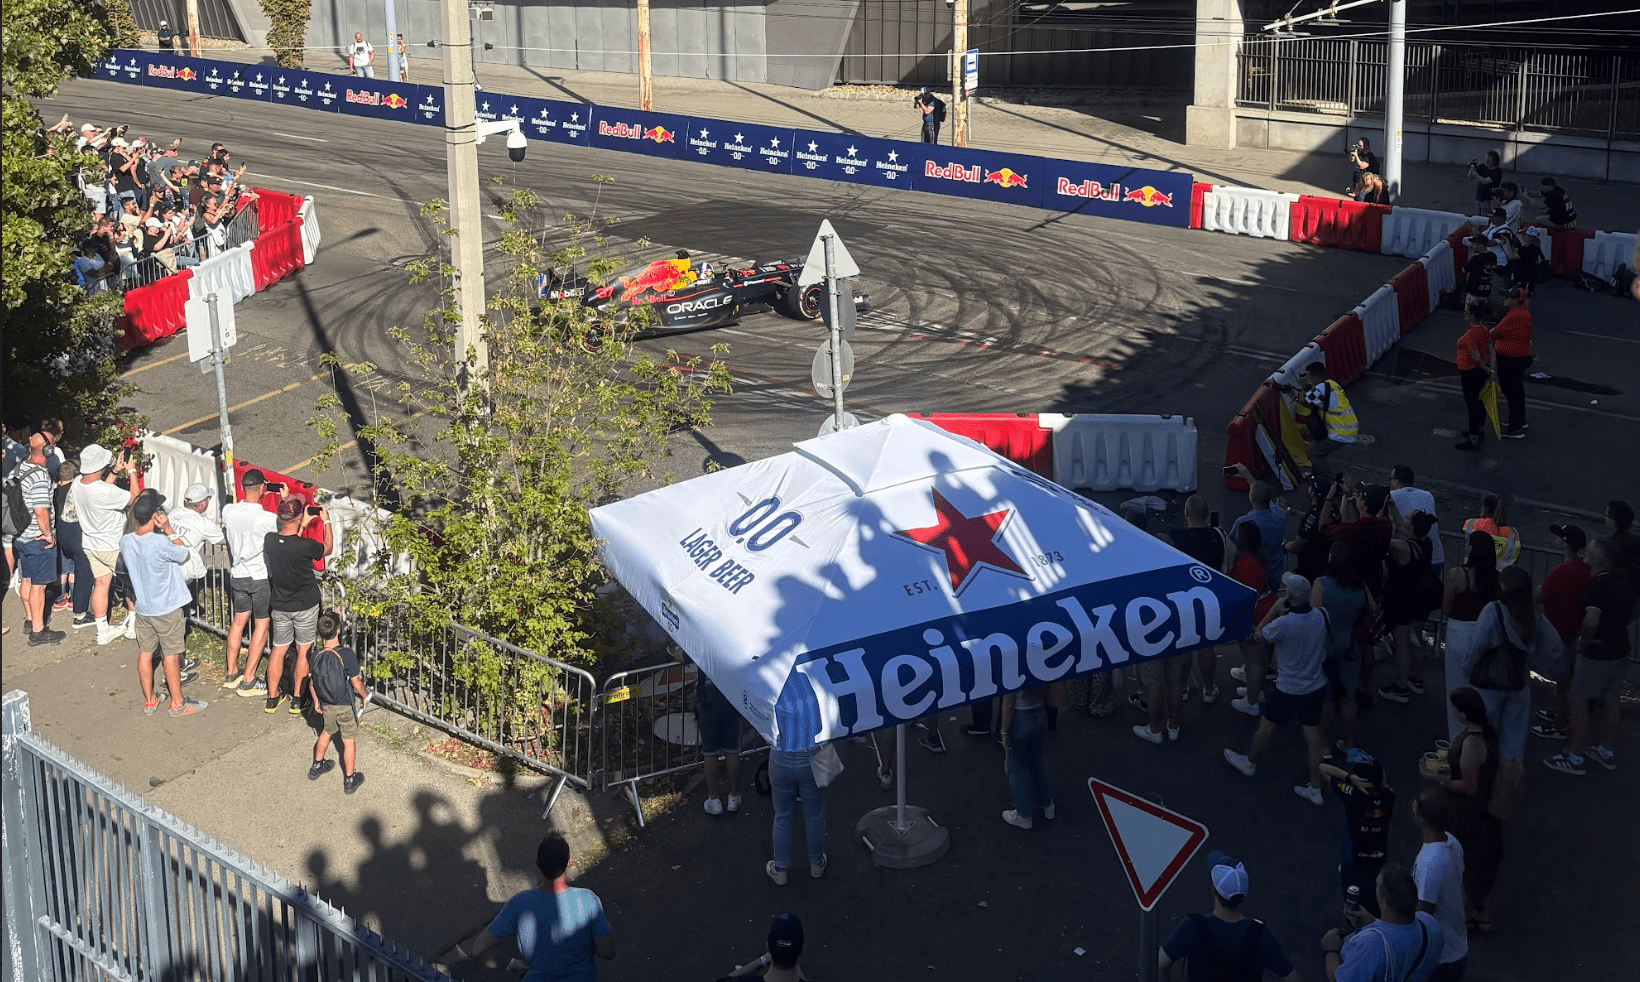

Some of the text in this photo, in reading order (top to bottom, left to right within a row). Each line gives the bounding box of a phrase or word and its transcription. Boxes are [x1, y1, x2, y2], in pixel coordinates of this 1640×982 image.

[690, 137, 718, 147] Heineken
[724, 142, 753, 152] Heineken
[759, 147, 789, 157] Heineken
[796, 151, 828, 161] Heineken
[835, 156, 868, 166] Heineken
[876, 160, 909, 171] Heineken
[666, 294, 733, 315] ORACLE
[726, 494, 804, 553] 0.0
[679, 527, 756, 595] LAGER BEER
[1030, 550, 1065, 568] 1873
[902, 579, 939, 597] EST.
[796, 585, 1227, 745] Heineken
